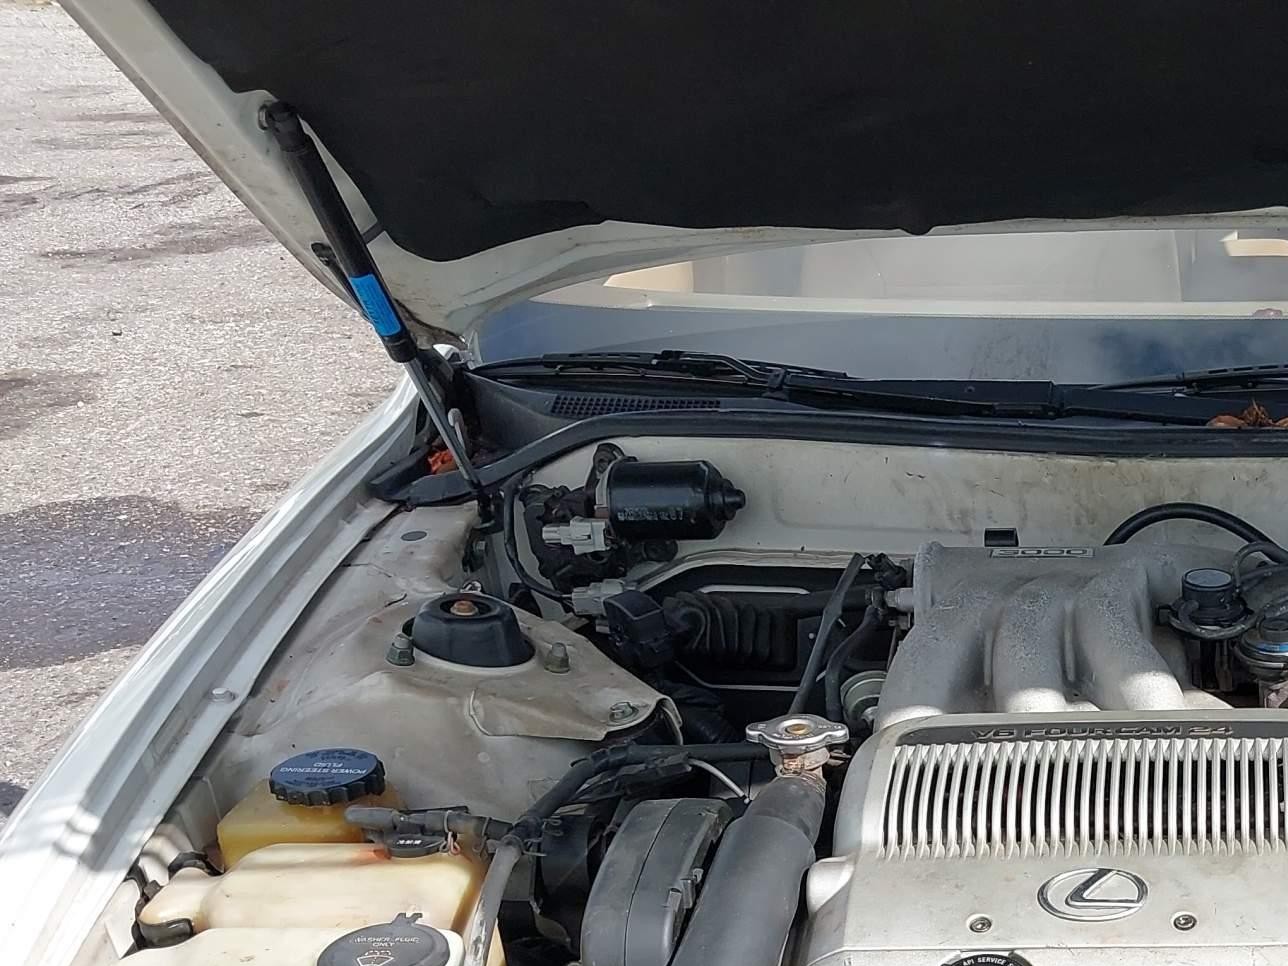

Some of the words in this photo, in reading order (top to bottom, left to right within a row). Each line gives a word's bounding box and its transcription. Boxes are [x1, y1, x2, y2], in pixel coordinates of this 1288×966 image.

[973, 729, 1015, 739] V6
[1024, 728, 1112, 738] FOUR
[1116, 726, 1182, 737] CAM
[1189, 725, 1234, 736] 24
[962, 958, 975, 966] API
[977, 956, 1007, 966] SERVICE
